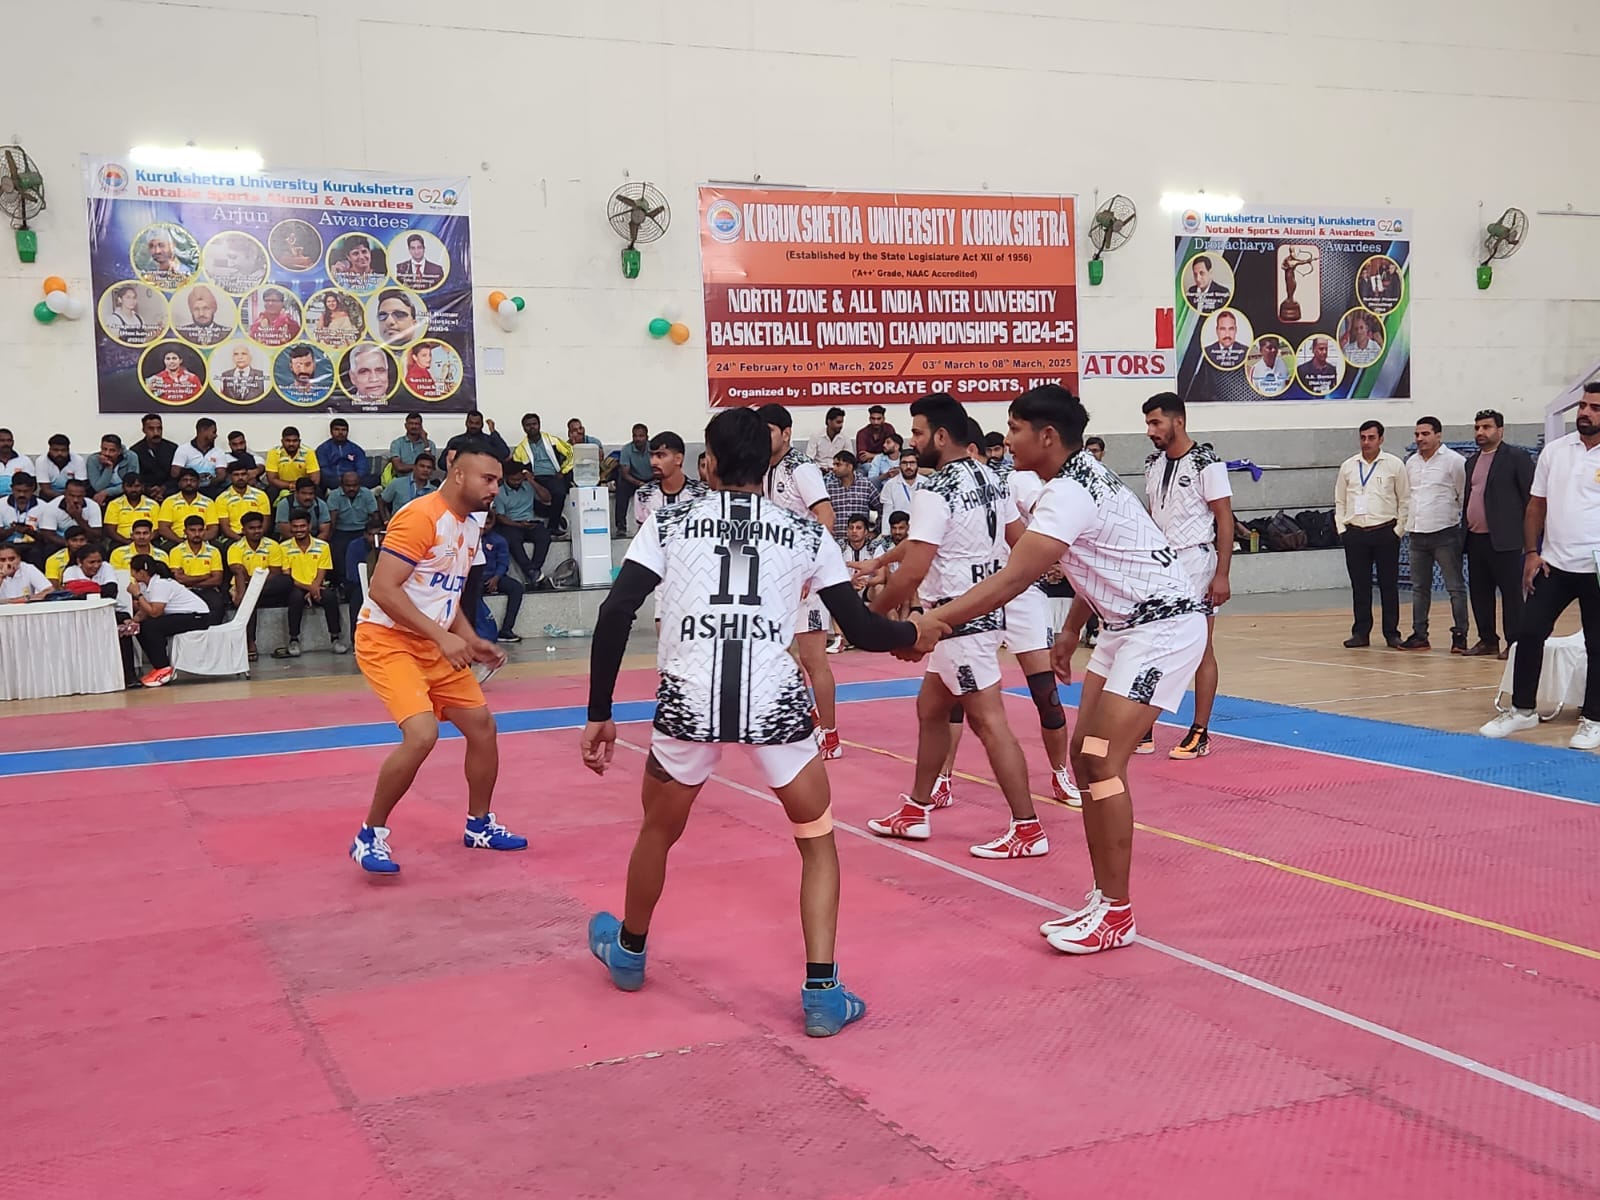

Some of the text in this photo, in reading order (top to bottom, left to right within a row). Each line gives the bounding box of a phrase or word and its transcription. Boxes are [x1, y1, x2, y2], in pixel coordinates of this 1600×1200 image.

[135, 169, 234, 187] Kurukshetra
[240, 175, 318, 194] University
[323, 180, 414, 196] Kurukshetra
[137, 185, 414, 210] Notable Sports Alumni & Awardees
[212, 206, 409, 229] Arjun Awardees
[743, 203, 1070, 247] KURUKSHETRA UNIVERSITY KURUKSHETRA
[1204, 213, 1264, 224] Kurukshetra
[1268, 214, 1315, 226] University
[1319, 216, 1375, 226] Kurukshetra
[1205, 225, 1244, 234] Notable
[1247, 226, 1279, 236] Sports
[1283, 227, 1315, 235] Alumni
[1319, 228, 1325, 236] &
[1329, 228, 1375, 237] Awardees
[1194, 238, 1382, 253] Dronacharya Awardees
[785, 250, 1032, 263] (Established by the State Legislature Act XII of 1956)
[877, 270, 904, 279] Grade,
[906, 270, 929, 278] NAAC
[931, 270, 978, 279] Accredited)
[728, 288, 1057, 314] NORTH ZONE & ALL INDIA INTER UNIVERSITY
[711, 320, 1074, 349] BASKETBALL (WOMEN) CHAMPIONSHIPS 2024-25
[716, 361, 894, 374] 24th February to 01st March, 2025
[922, 358, 1072, 370] 03rd March to 08th March, 2025
[1082, 354, 1166, 375] ATORS
[728, 387, 784, 398] Organized
[787, 387, 800, 398] by
[811, 381, 926, 396] DIRECTORATE
[931, 380, 952, 393] OF
[957, 379, 1024, 395] SPORTS,
[684, 518, 795, 549] HARYANA
[709, 545, 762, 605] 11
